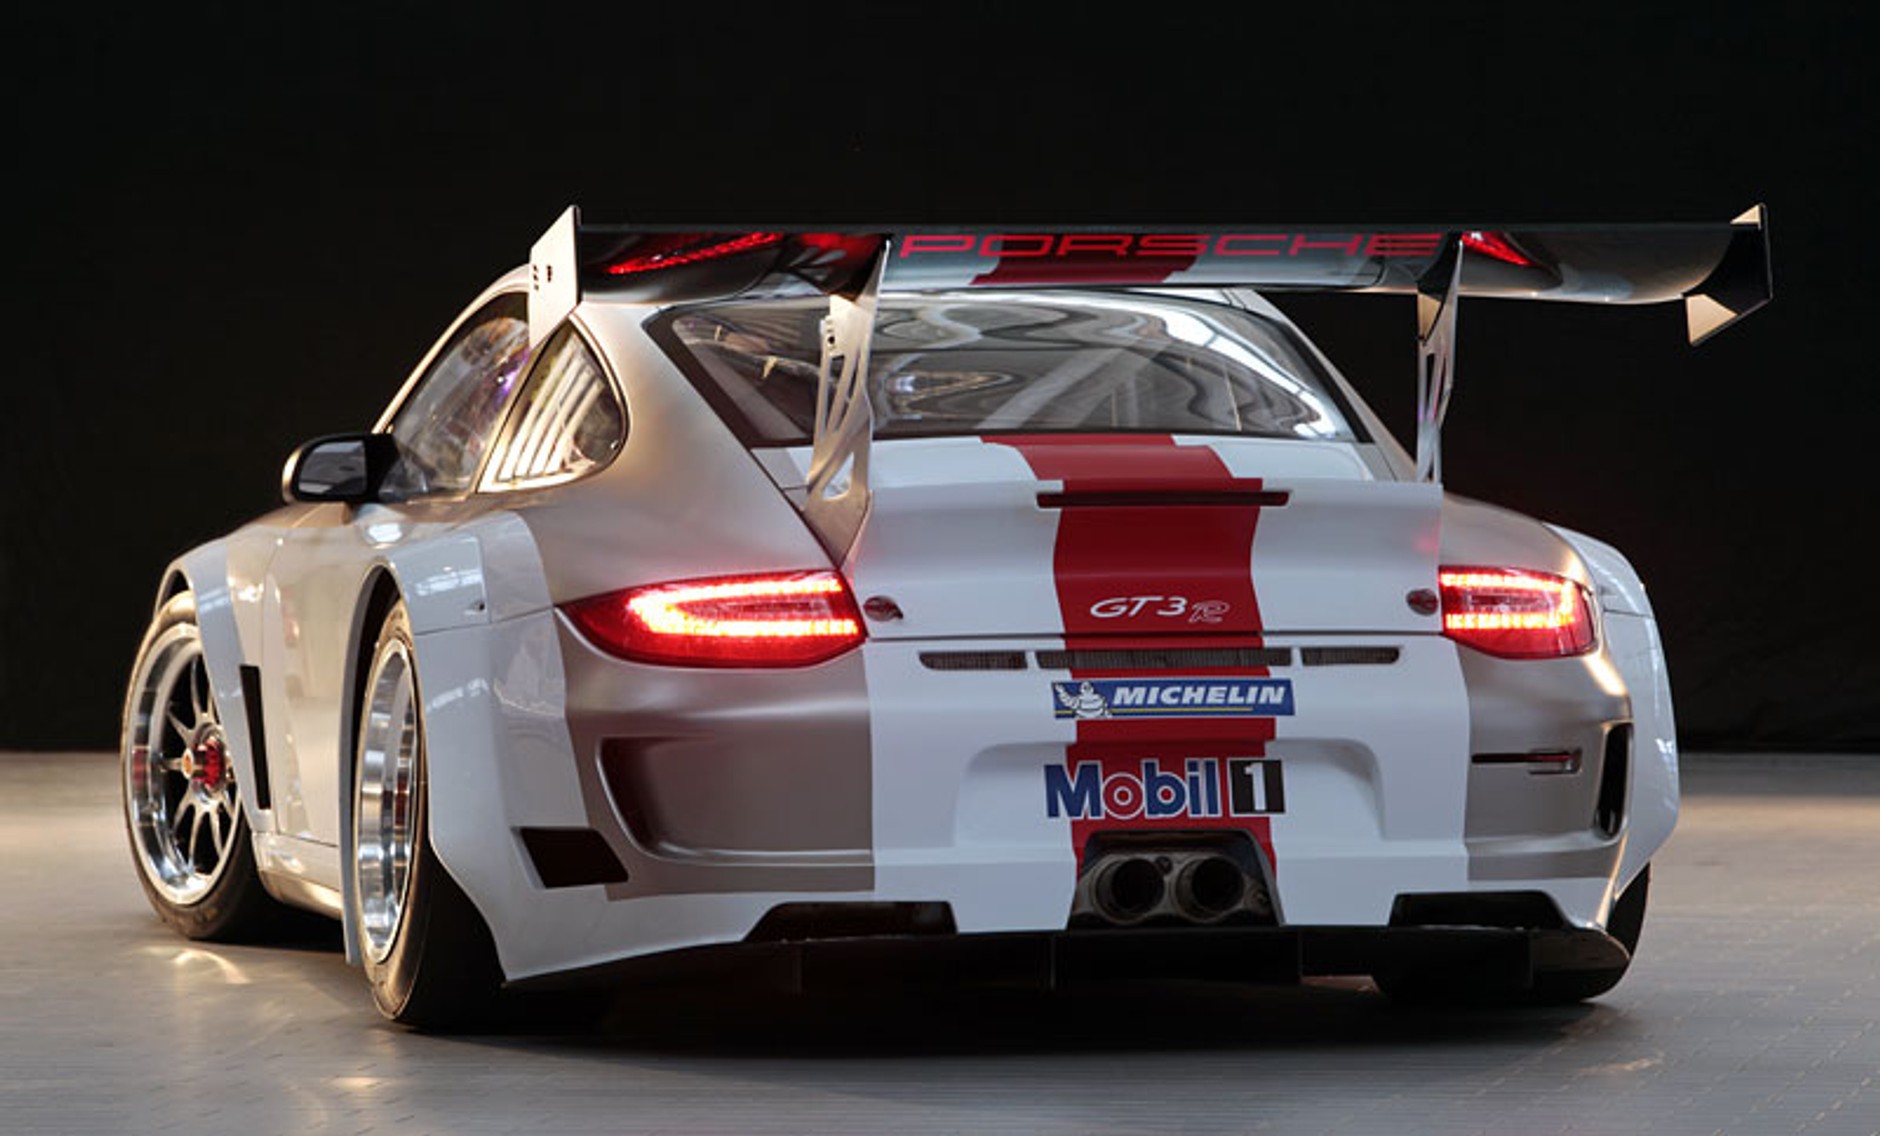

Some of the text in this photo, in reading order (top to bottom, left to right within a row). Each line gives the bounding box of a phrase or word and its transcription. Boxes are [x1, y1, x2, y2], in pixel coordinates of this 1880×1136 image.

[899, 233, 1443, 259] PORSCHE
[1112, 686, 1286, 706] MICHELIN
[1044, 758, 1268, 820] Mobil 1
